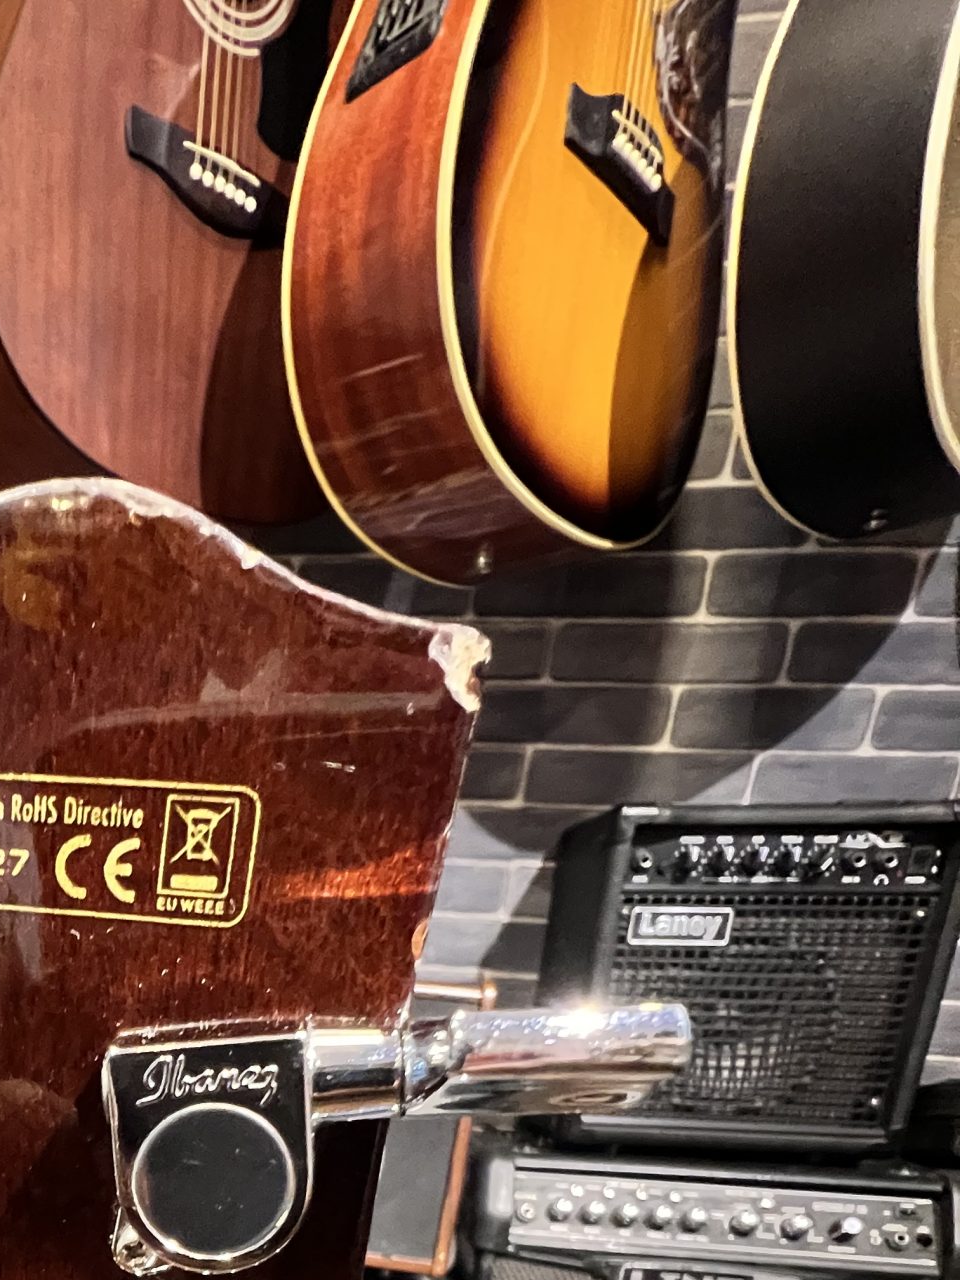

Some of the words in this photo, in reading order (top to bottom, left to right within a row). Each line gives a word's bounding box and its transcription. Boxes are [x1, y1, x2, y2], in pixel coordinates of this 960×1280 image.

[10, 793, 58, 825] RoHS
[63, 796, 145, 829] Directive
[54, 834, 141, 904] CE
[156, 896, 178, 911] EU
[179, 898, 225, 915] WEEE
[638, 911, 723, 940] Laney
[135, 1053, 279, 1107] Ibanez
